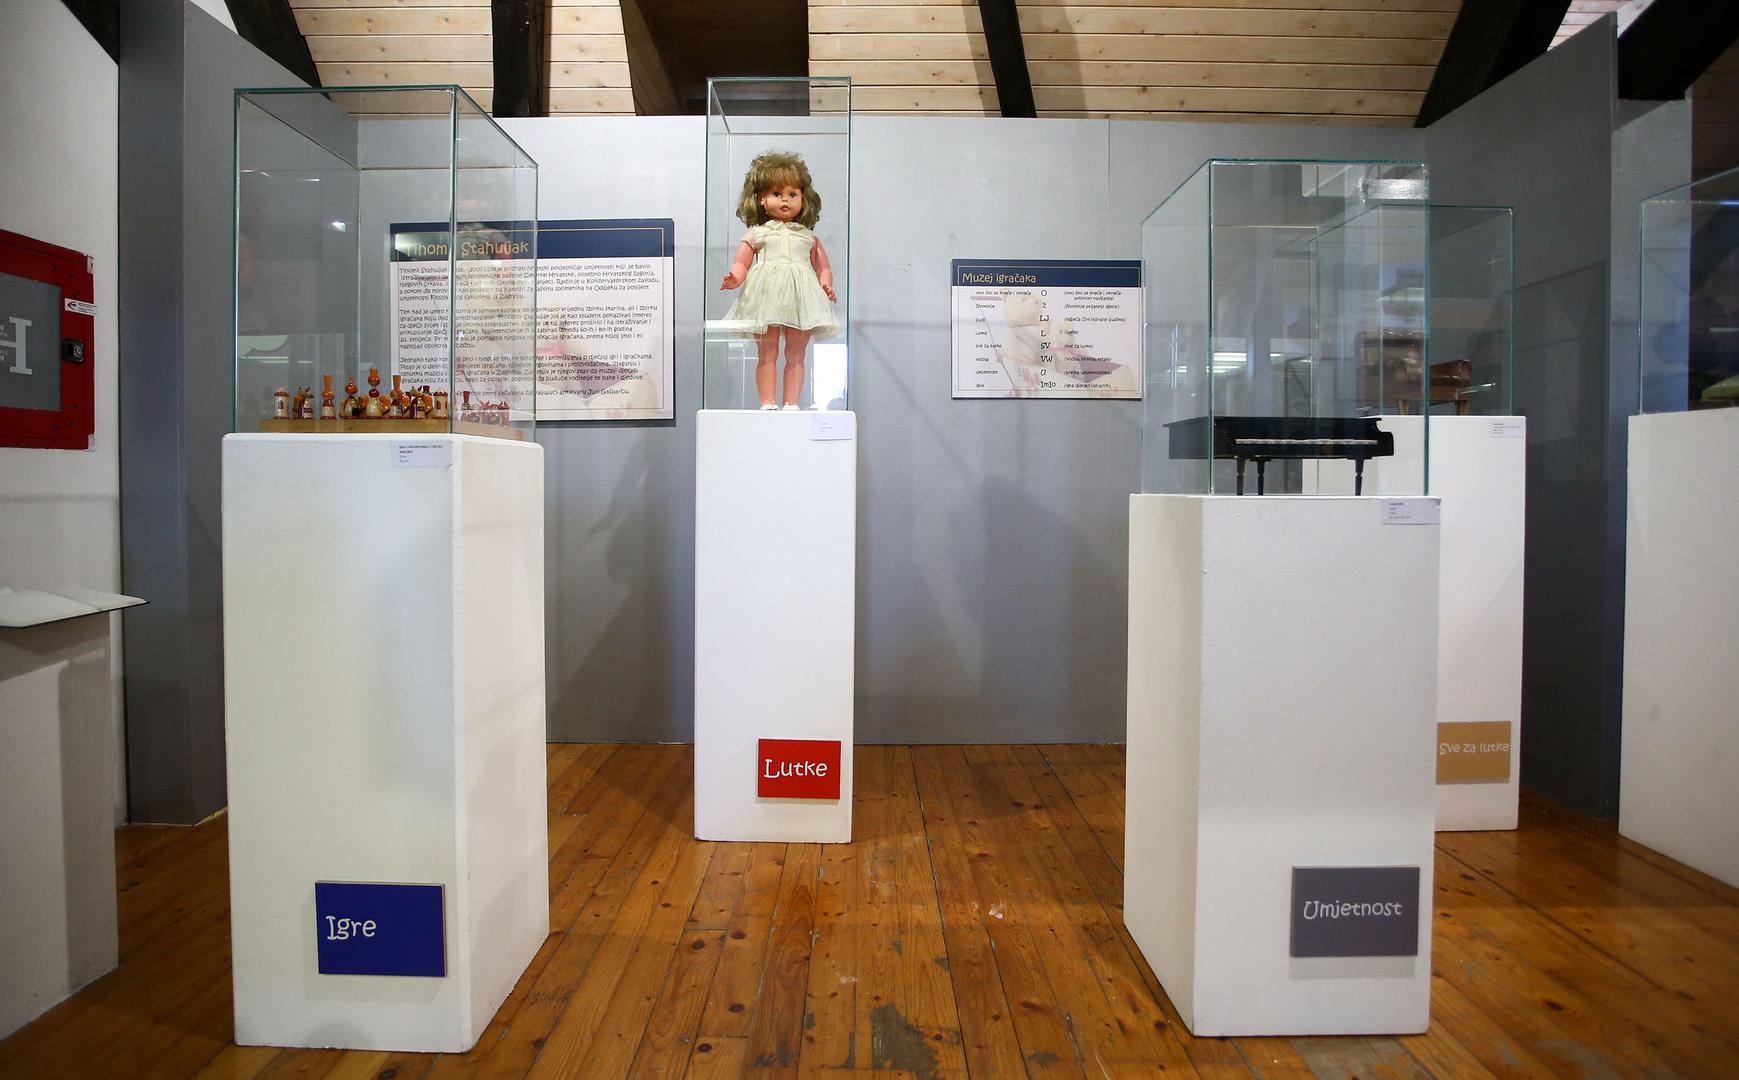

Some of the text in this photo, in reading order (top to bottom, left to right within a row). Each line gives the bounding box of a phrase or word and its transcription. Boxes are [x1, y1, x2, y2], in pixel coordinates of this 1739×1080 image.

[461, 241, 529, 257] Stahuljak
[962, 273, 1037, 284] Muzej igračaka
[1040, 355, 1053, 363] VW
[1440, 742, 1510, 756] Sve za lutke
[763, 758, 828, 779] Lutke
[1303, 900, 1402, 920] Umjetnost
[325, 915, 377, 940] Igre
